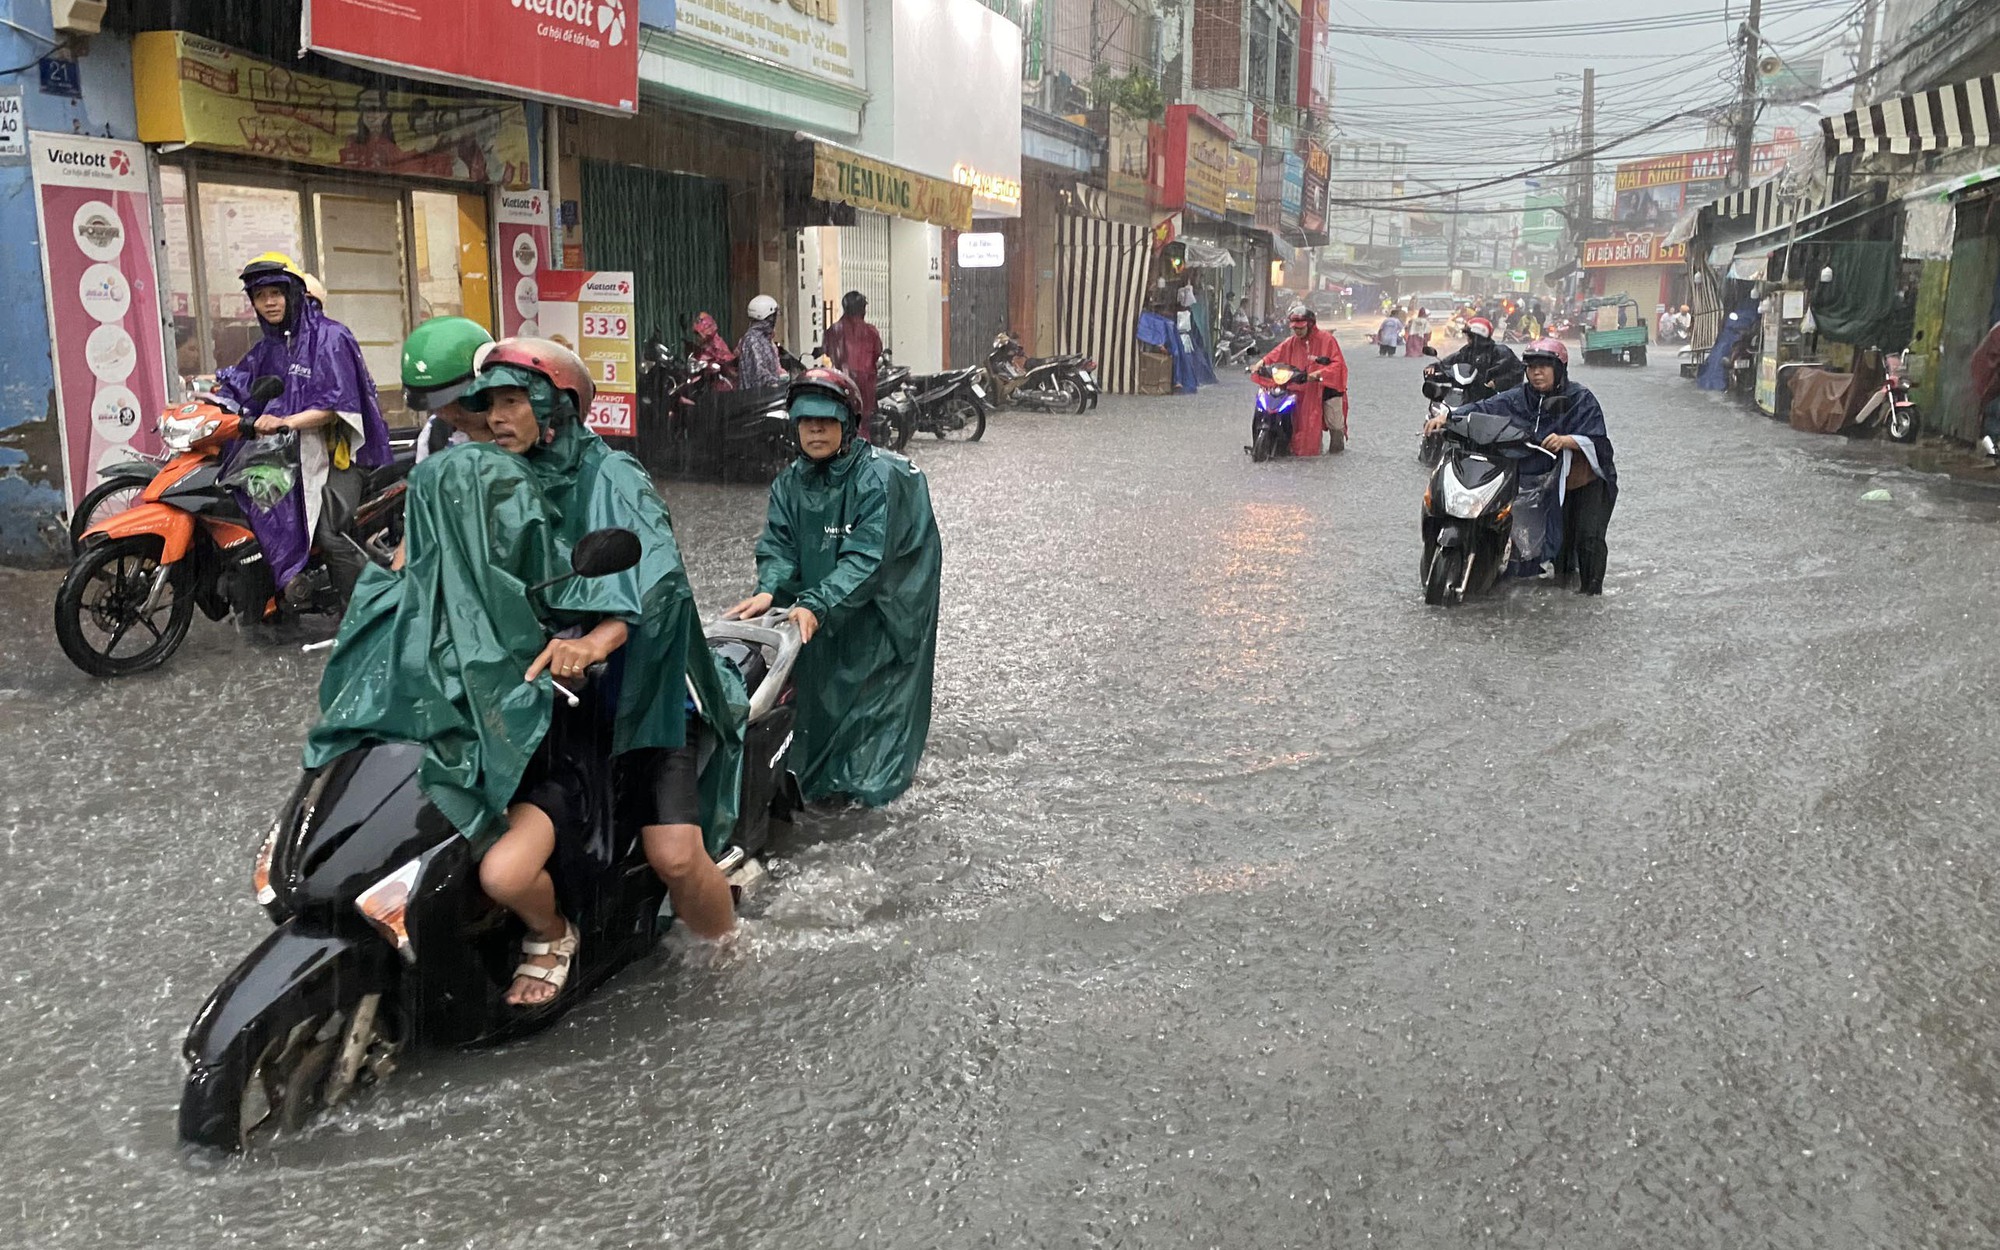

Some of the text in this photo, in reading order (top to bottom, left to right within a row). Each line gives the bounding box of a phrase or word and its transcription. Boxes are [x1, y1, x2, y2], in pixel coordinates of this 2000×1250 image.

[511, 0, 594, 27] etlott
[50, 61, 69, 81] 21
[47, 148, 106, 167] Vietlott
[837, 158, 874, 203] TIỆM
[876, 167, 910, 209] VÀNG
[586, 282, 617, 291] Vietlott
[584, 316, 628, 336] 33.9
[605, 363, 616, 382] 3
[593, 395, 625, 404] JACKPOT
